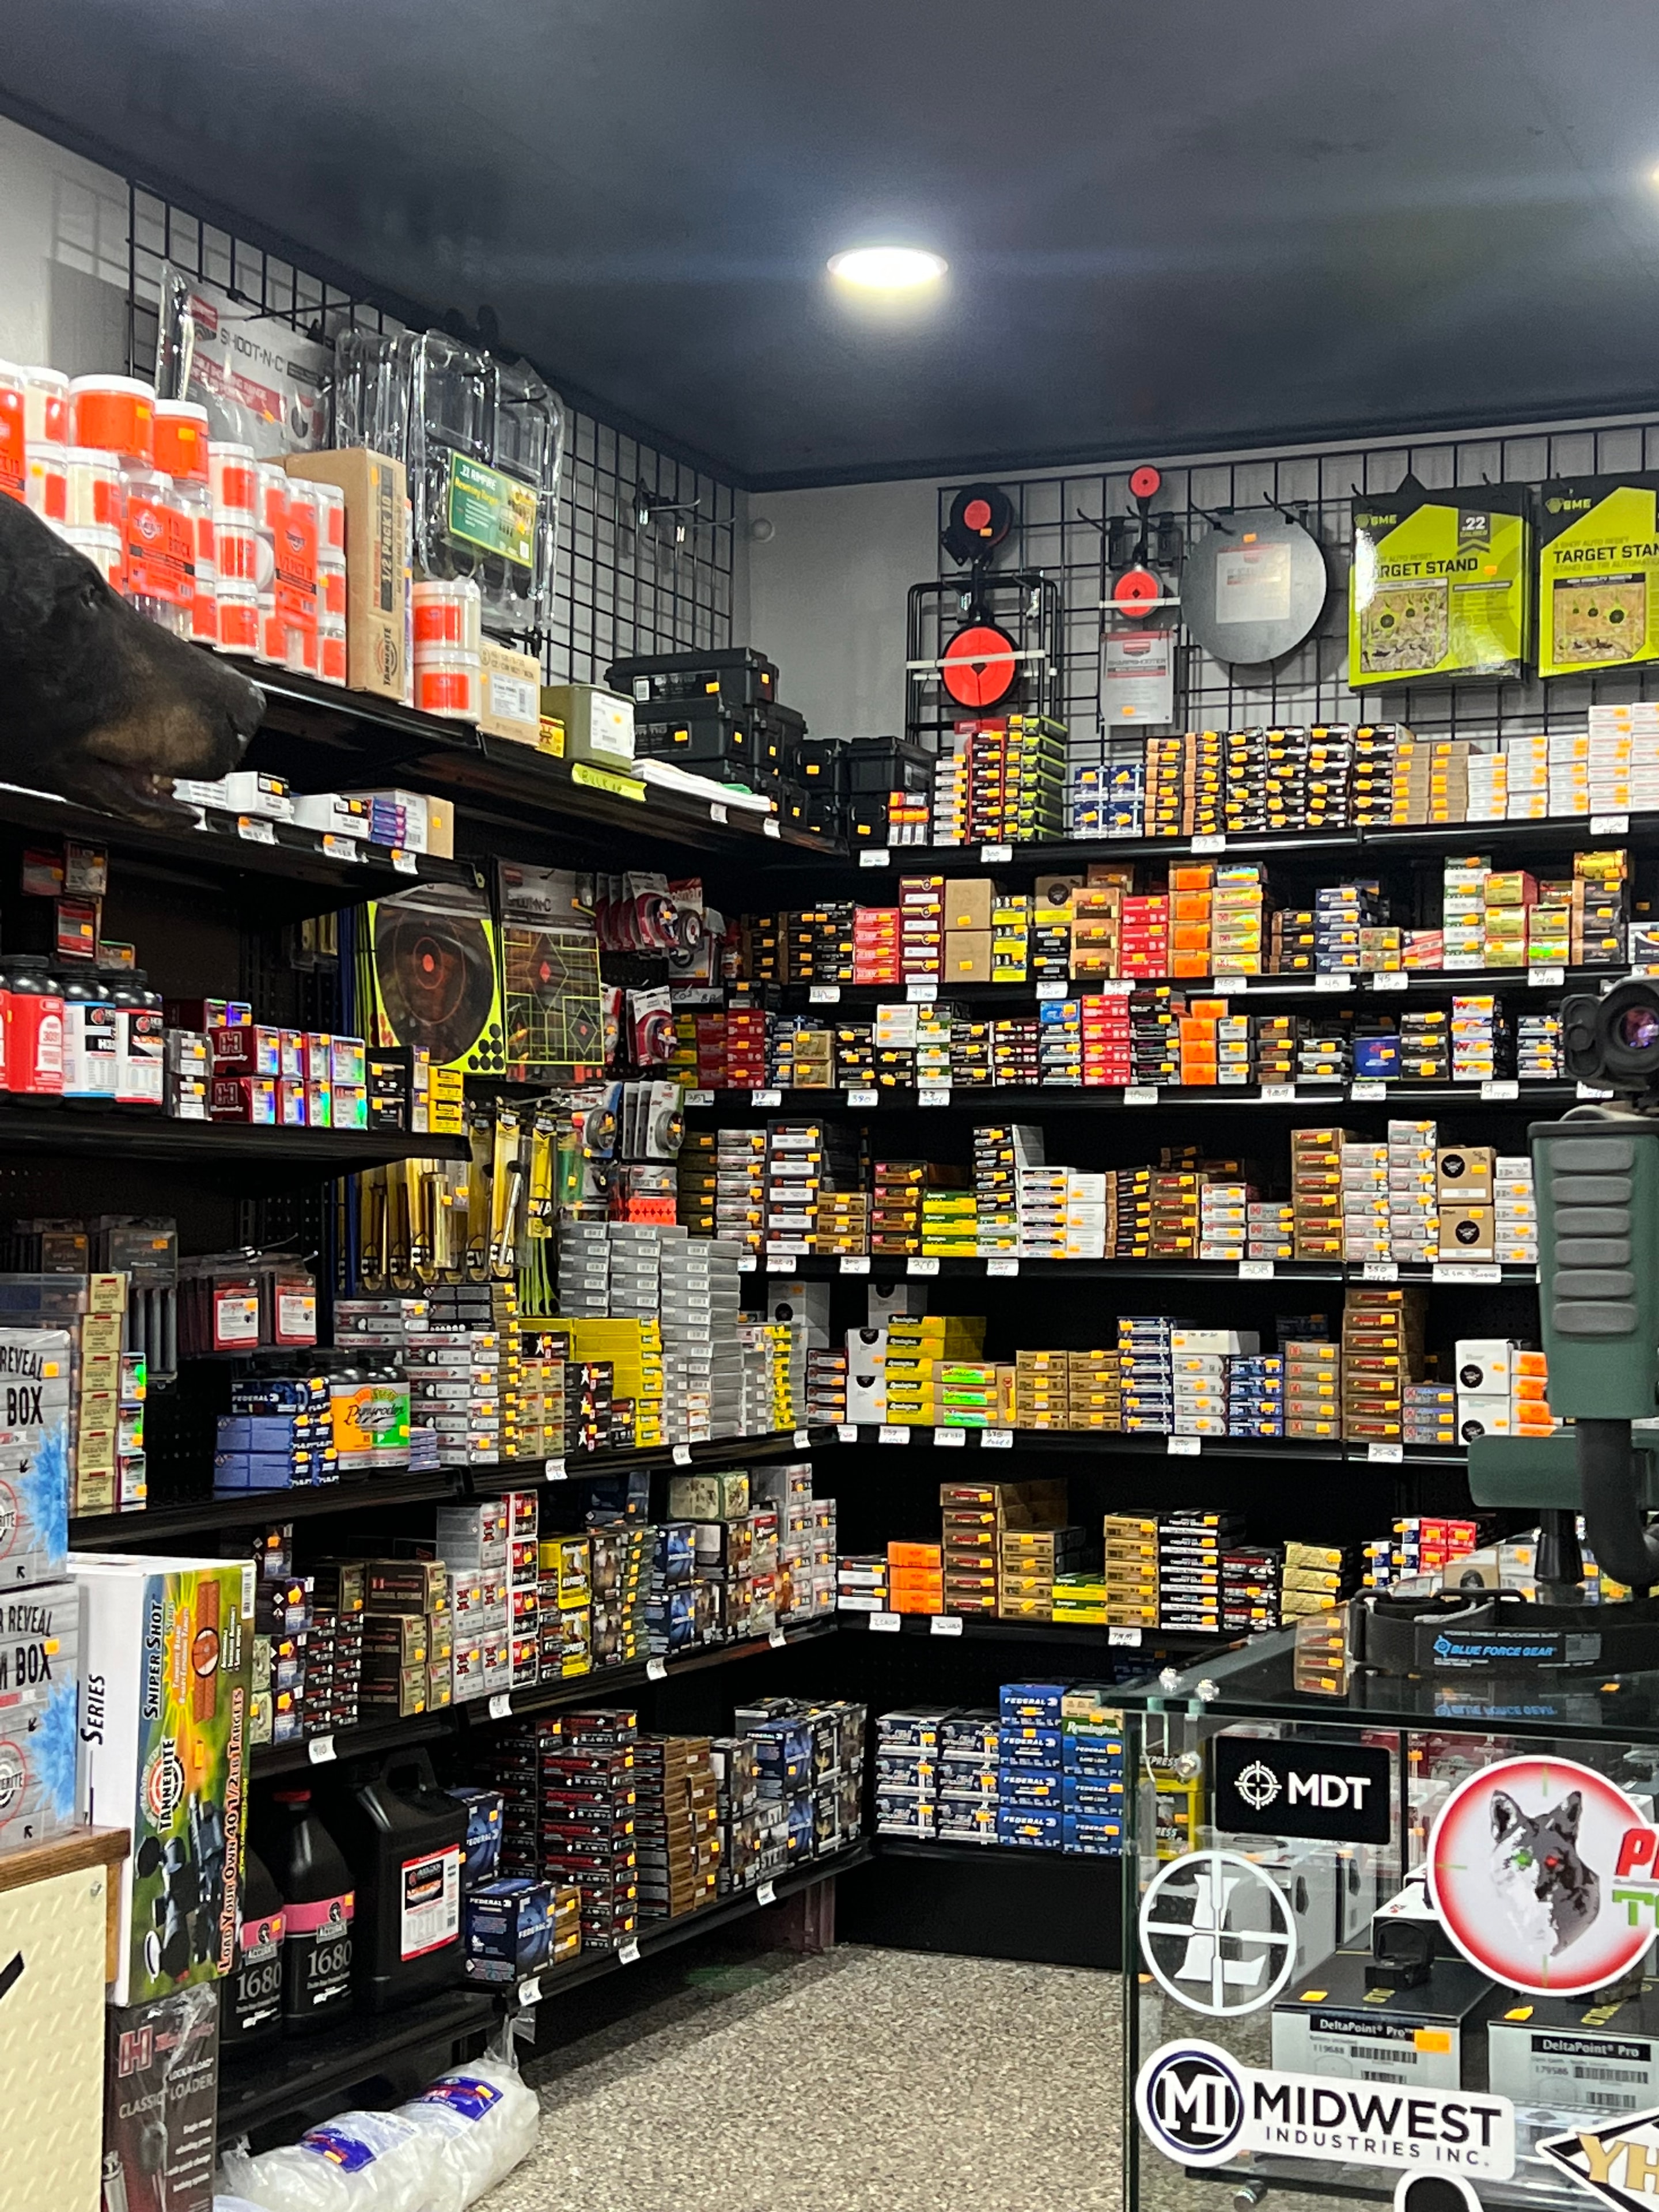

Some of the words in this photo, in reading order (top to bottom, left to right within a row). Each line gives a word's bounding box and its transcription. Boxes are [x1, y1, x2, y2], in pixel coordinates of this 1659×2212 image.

[1461, 516, 1486, 531] .22
[1426, 558, 1478, 574] STAND
[1553, 546, 1617, 564] TARGET
[7, 1386, 43, 1426] BOX
[9, 1605, 53, 1637] REVEAL
[16, 1643, 52, 1687] BOX
[1450, 1645, 1482, 1656] BLUE
[1482, 1646, 1522, 1657] FORCE
[1523, 1646, 1554, 1657] GEAR
[143, 1653, 161, 1719] SNIPER
[1004, 1696, 1046, 1705] FEDERAL
[81, 1674, 105, 1745] SERIES
[1002, 1737, 1044, 1745] FEDERAL
[1066, 1720, 1120, 1736] Remington
[158, 1740, 175, 1830] TANNERITE
[1002, 1776, 1044, 1785] FEDERAL
[1288, 1771, 1372, 1810] MDT
[224, 1812, 237, 1838] 40
[1002, 1816, 1044, 1824] FEDERAL
[223, 1840, 237, 1881] OWN
[470, 1897, 502, 1907] FEDERAL
[518, 1922, 548, 1939] FEDERAL
[307, 1940, 353, 1978] 1680
[236, 1961, 282, 2002] 1680
[1618, 2045, 1639, 2058] Pro
[119, 2091, 165, 2119] CLASSIC
[170, 2073, 214, 2101] LOADER
[1159, 2070, 1233, 2139] MI
[1253, 2081, 1502, 2147] MIDWEST
[1266, 2126, 1422, 2157] INDUSTRIES
[1436, 2145, 1490, 2166] INC.
